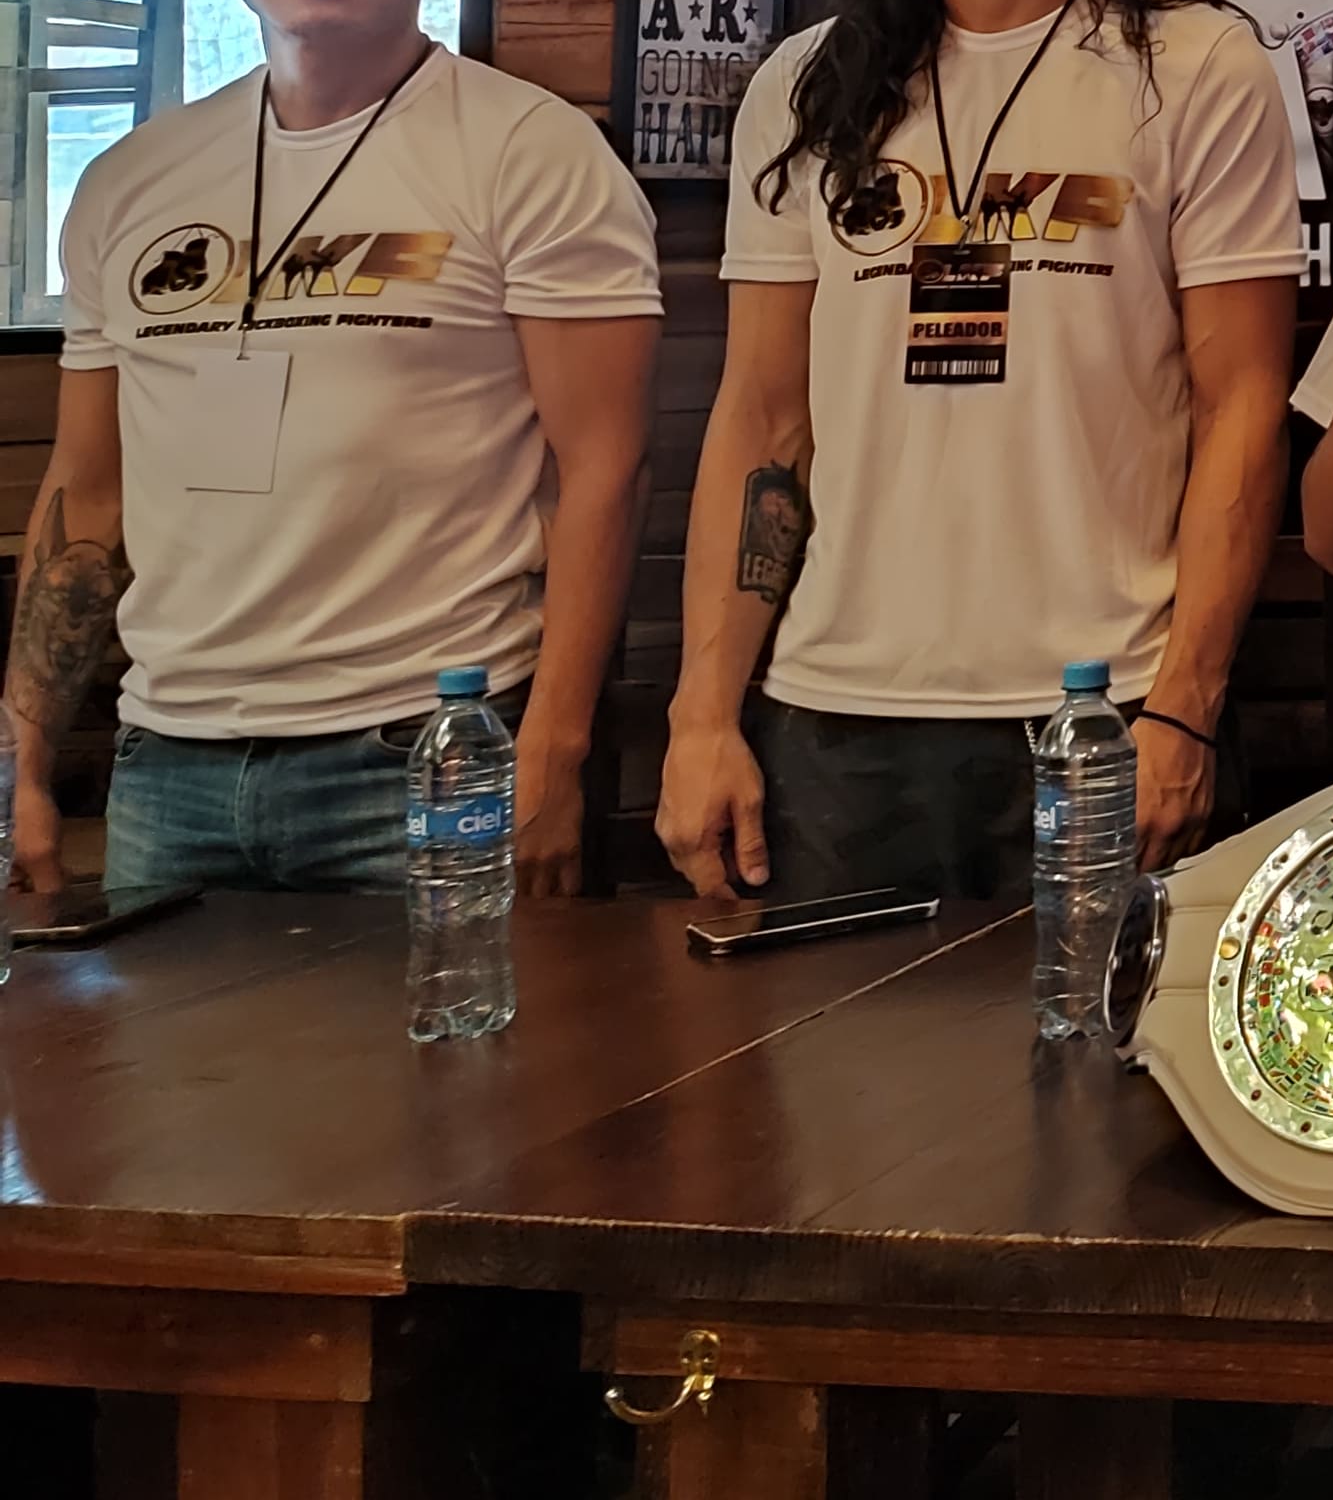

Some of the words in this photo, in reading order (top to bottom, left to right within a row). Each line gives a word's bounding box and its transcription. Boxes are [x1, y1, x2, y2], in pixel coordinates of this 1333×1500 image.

[1037, 259, 1114, 277] FIGHTERS
[136, 316, 235, 340] LEGENDARY
[336, 312, 433, 329] FIGHTERS
[912, 322, 1003, 339] PELEADOR
[457, 806, 502, 835] ciel
